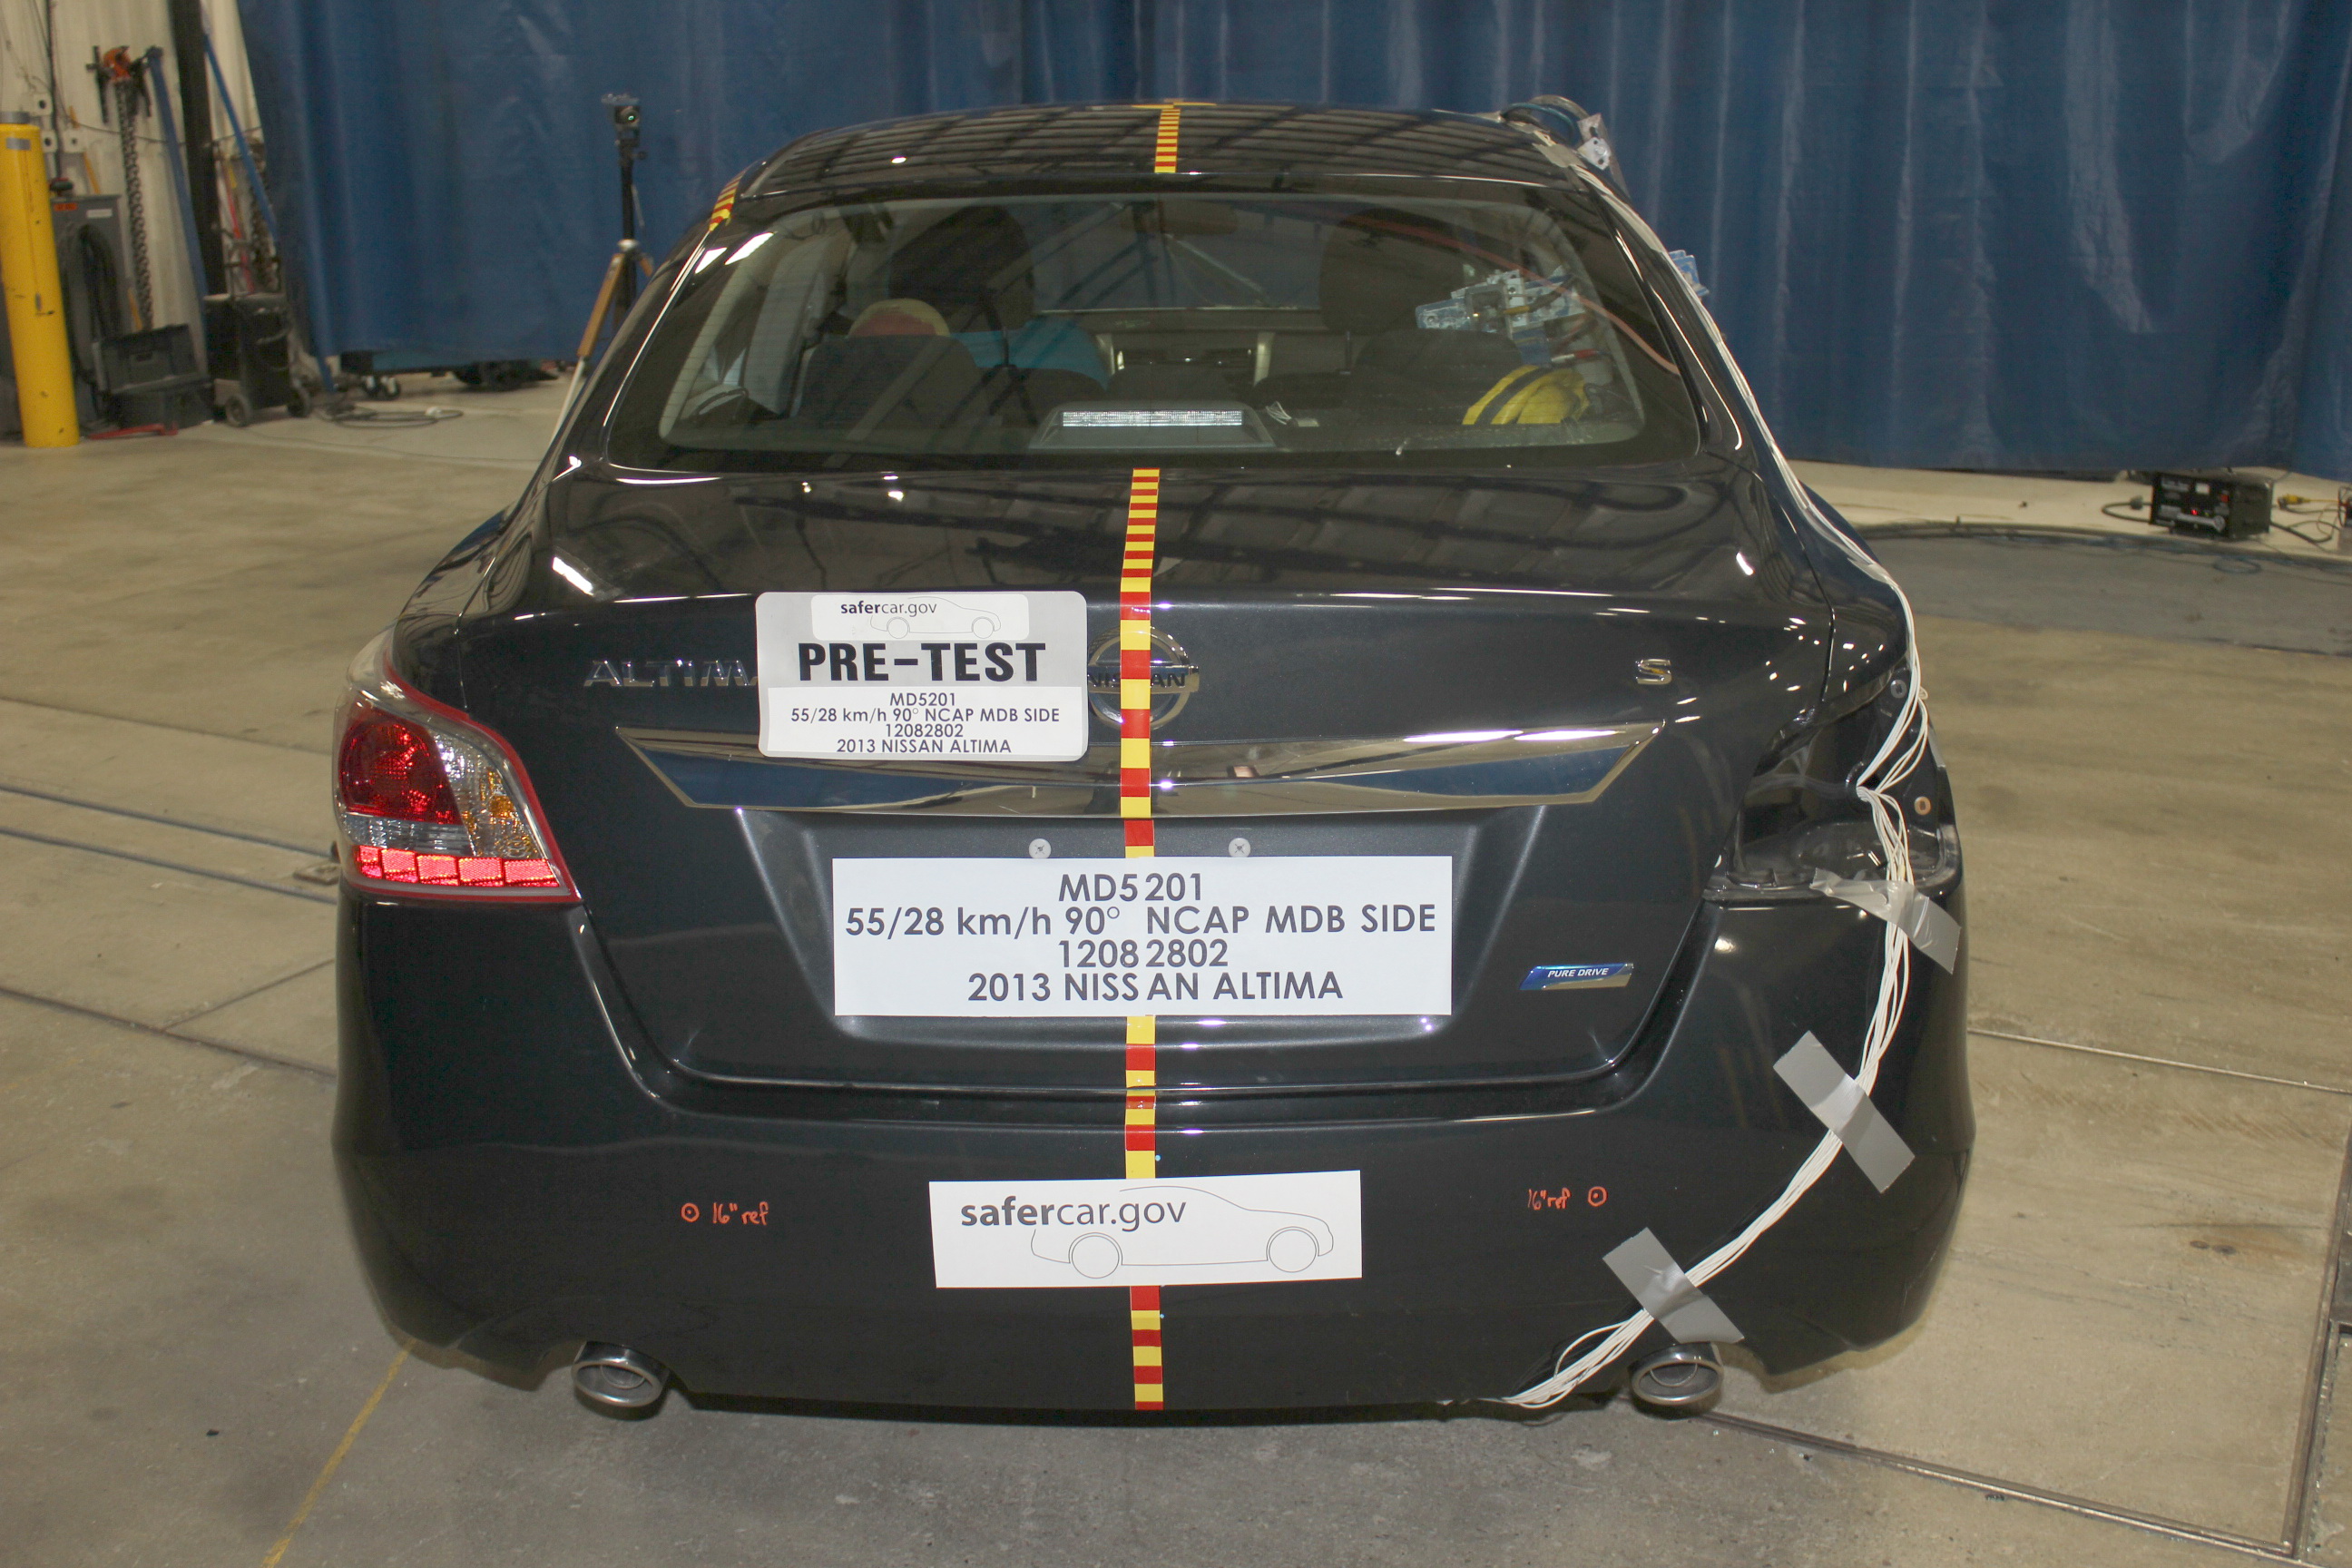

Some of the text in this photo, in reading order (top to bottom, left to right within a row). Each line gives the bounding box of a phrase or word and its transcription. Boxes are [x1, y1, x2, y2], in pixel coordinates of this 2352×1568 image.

[840, 600, 937, 618] safercar.gov
[583, 660, 758, 687] ALTIM
[799, 642, 1045, 681] PRE-TEST
[1636, 659, 1671, 685] S
[889, 692, 955, 707] MD5201
[790, 707, 1060, 724] 55/28 km/h 90° NCAP MDB SIDE
[886, 723, 964, 738] 12082802
[837, 739, 1012, 753] 2013 NISSAN ALTIMA
[1059, 873, 1200, 901] MD5201
[846, 905, 1435, 938] 55/28 km/h 90° NCAP MDB SIDE
[1059, 939, 1228, 967] 12082802
[1547, 967, 1609, 978] PURE DRIVE
[968, 972, 1343, 1001] 2013 NISSAN ALTIMA
[741, 1201, 769, 1226] ref
[960, 1195, 1187, 1232] safercar.gov
